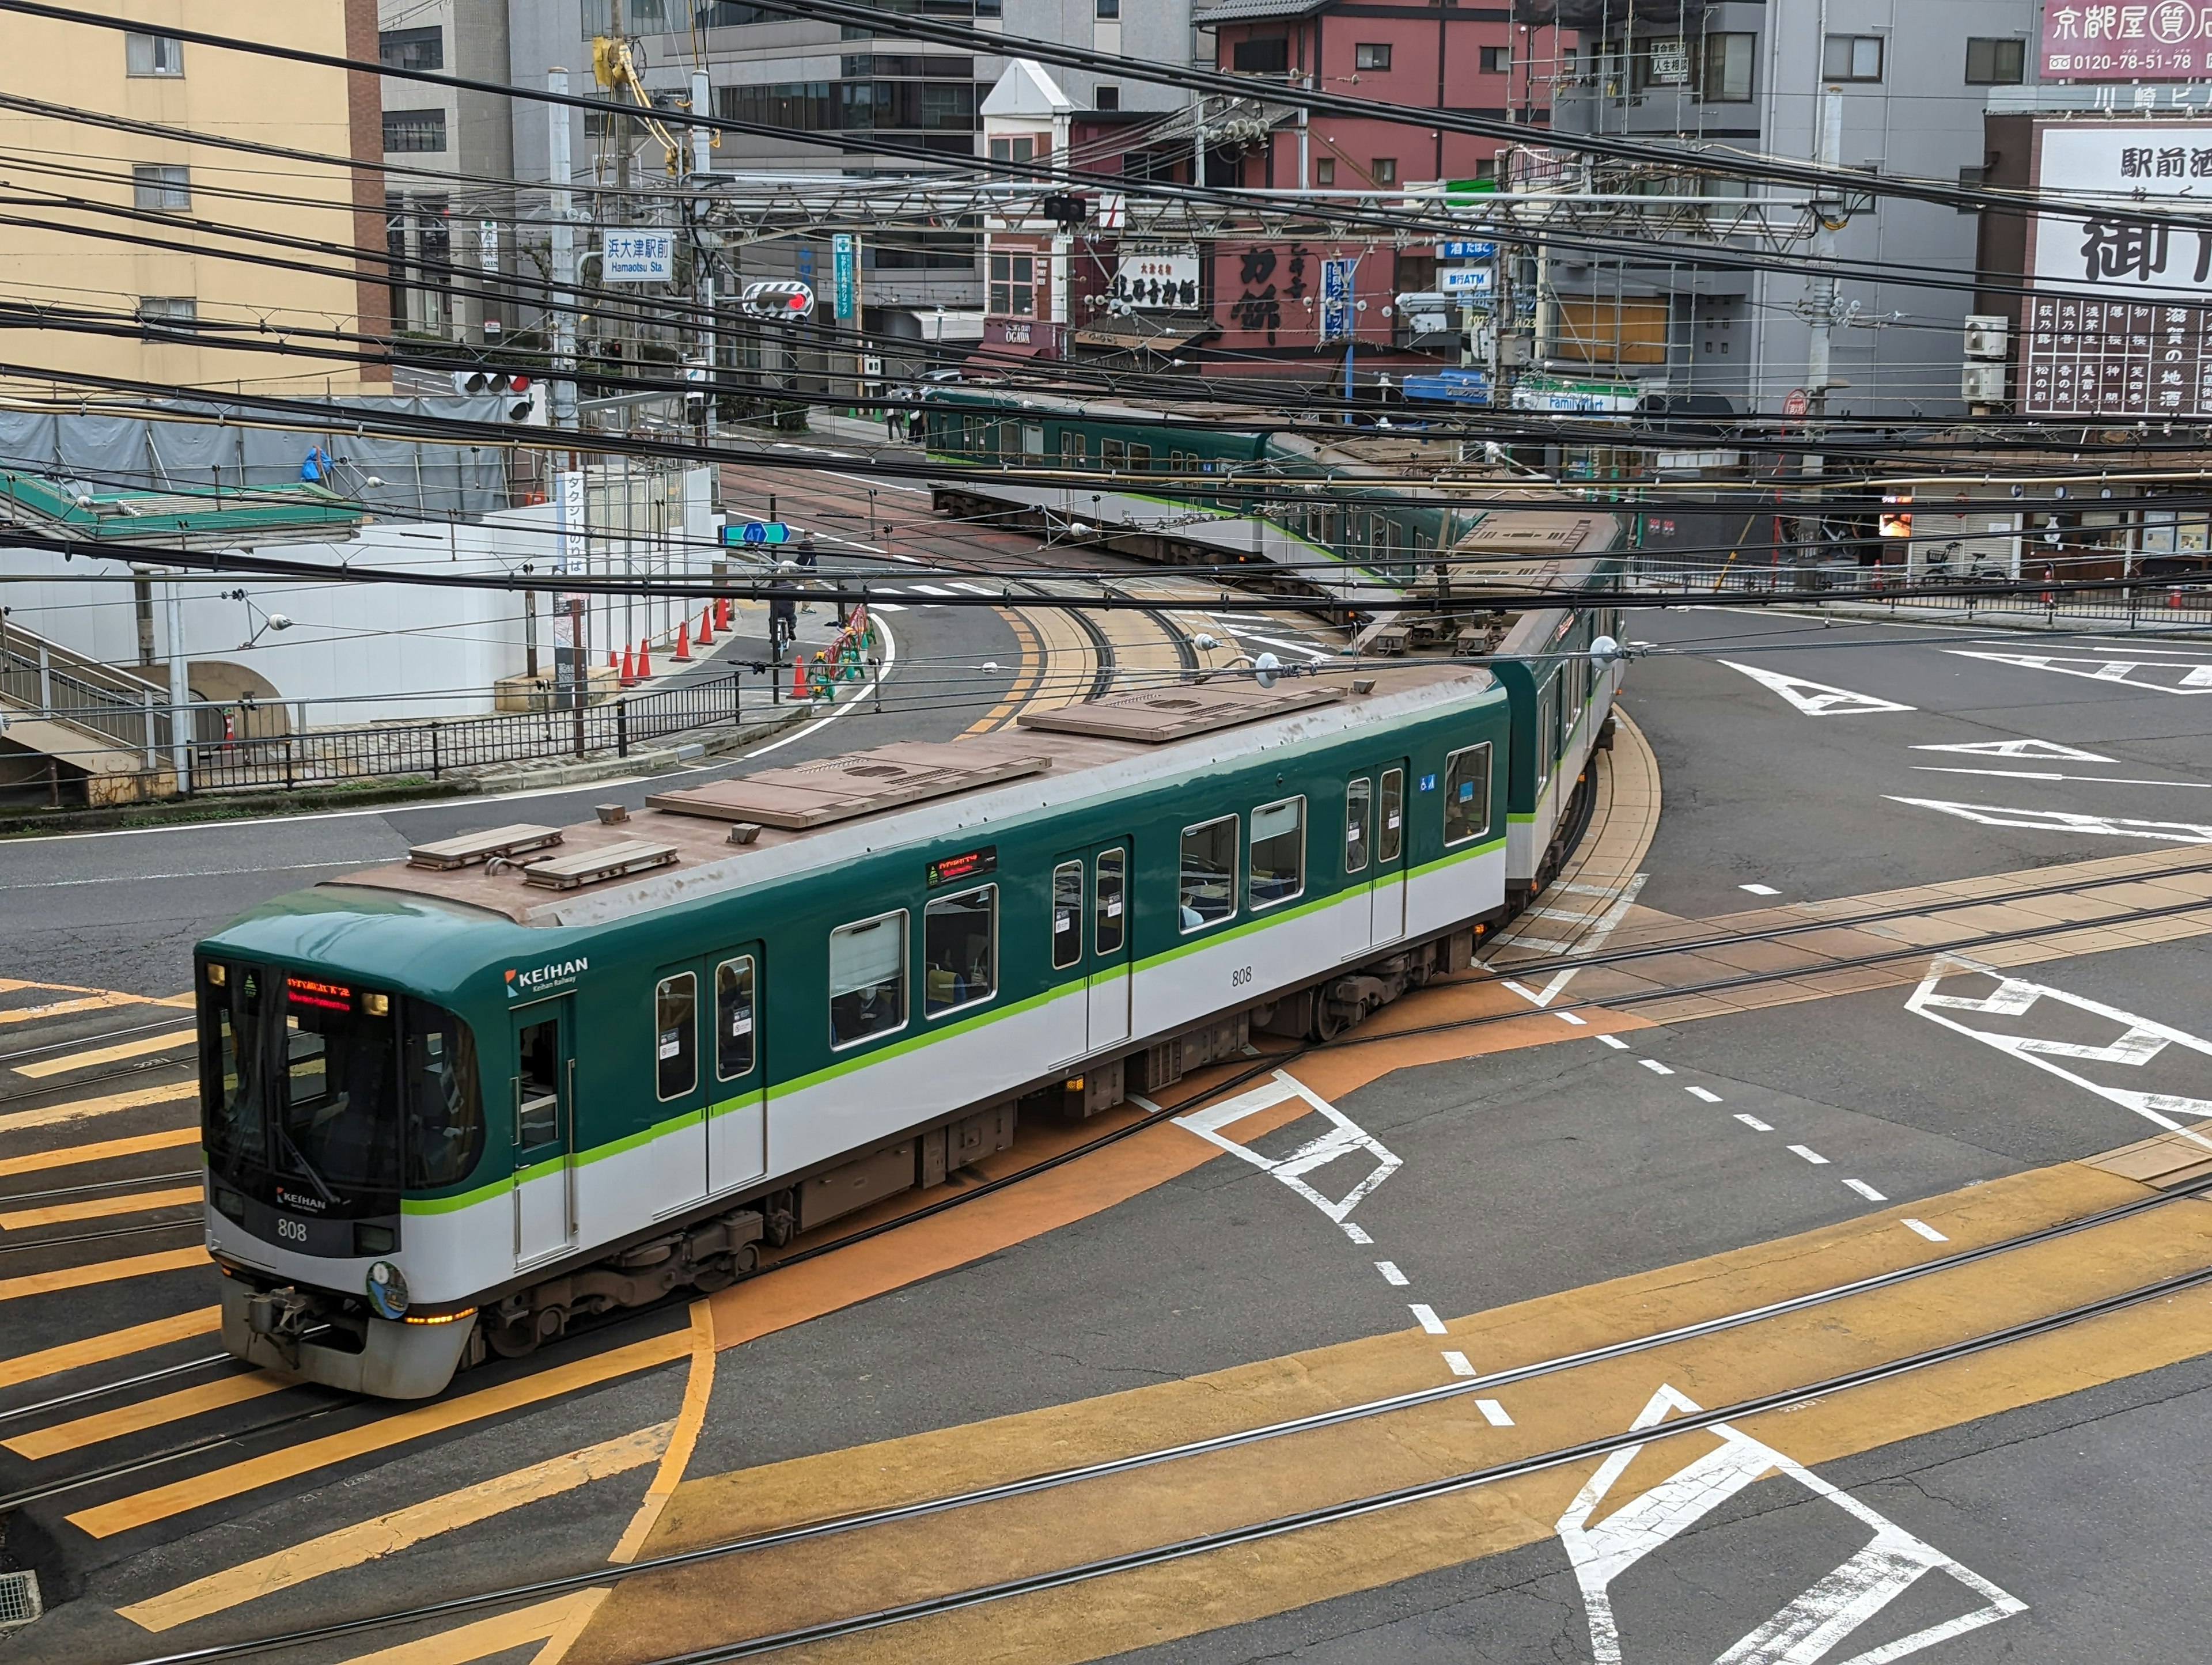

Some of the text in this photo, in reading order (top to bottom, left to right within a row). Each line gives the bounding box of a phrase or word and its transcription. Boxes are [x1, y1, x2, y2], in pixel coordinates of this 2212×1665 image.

[2074, 54, 2191, 70] 0120-78-51-78
[608, 238, 668, 259] 浜大津駅前
[2080, 215, 2212, 282] 御
[612, 261, 664, 272] Hamaotsu Sta.
[1449, 274, 1484, 285] 銀行ATM
[1006, 331, 1031, 344] OGAWA
[2159, 306, 2188, 407] 滋賀の地酒
[2033, 365, 2050, 403] 松の司
[1550, 397, 1604, 411] FamilyMrt
[568, 476, 582, 572] タクシーのりば
[747, 528, 762, 542] 47
[518, 957, 589, 987] KEIHAN
[1232, 965, 1252, 987] 808
[532, 976, 577, 992] Keihan Railway
[283, 1192, 327, 1209] KEIHAN
[278, 1218, 308, 1242] 808
